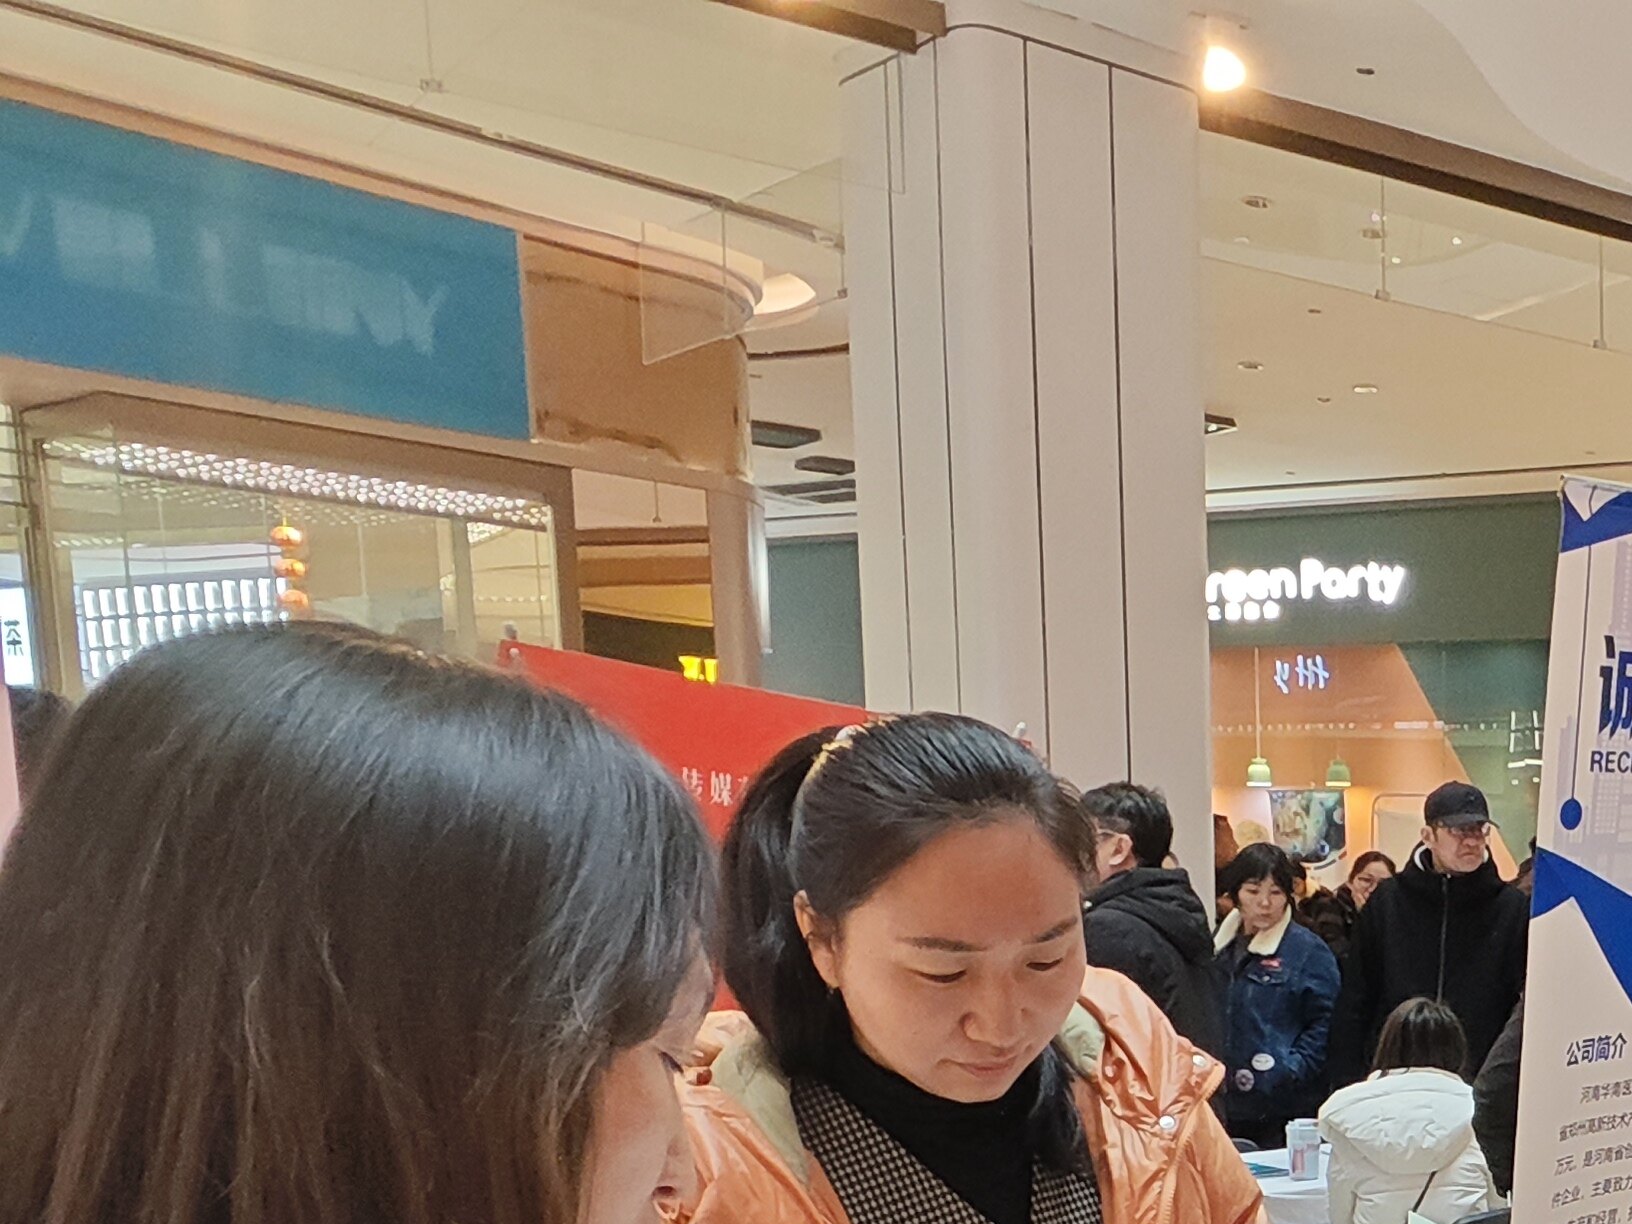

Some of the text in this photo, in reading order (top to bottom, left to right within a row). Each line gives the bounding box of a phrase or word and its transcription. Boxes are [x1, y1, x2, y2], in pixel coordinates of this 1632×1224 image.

[1300, 558, 1406, 604] Party
[682, 766, 748, 806] 传媒
[1566, 1032, 1628, 1067] 公司简介
